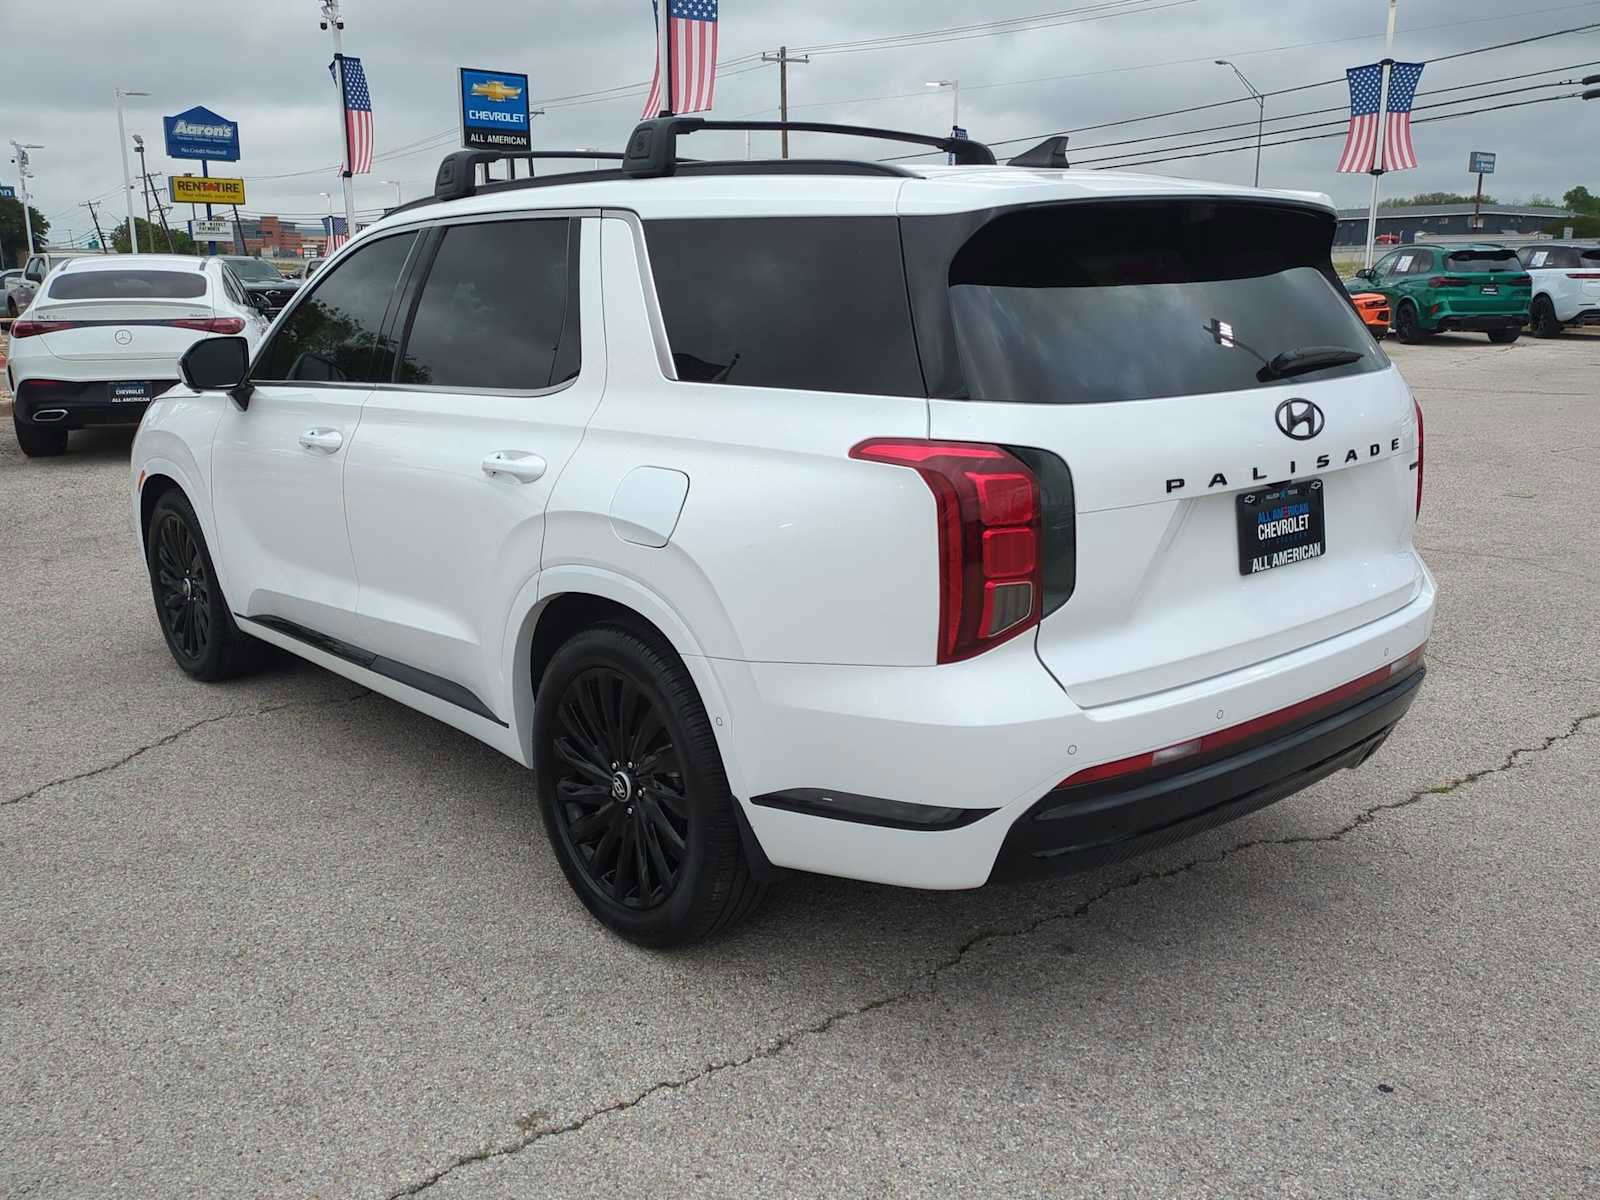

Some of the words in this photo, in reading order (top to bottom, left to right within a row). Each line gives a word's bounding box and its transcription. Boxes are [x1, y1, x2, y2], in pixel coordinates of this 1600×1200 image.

[469, 110, 524, 123] CHEVROLET
[173, 120, 233, 137] Aaron's
[471, 133, 485, 143] ALL
[487, 134, 527, 145] AMERICAN
[177, 181, 207, 191] RENT
[215, 183, 240, 193] TIRE
[1166, 438, 1400, 493] PALISADE
[1257, 511, 1272, 523] ALL
[1272, 503, 1309, 521] AMERICAN
[1257, 514, 1309, 540] CHEVROLET
[1252, 555, 1271, 572] ALL
[1272, 542, 1321, 567] AMERICAN
